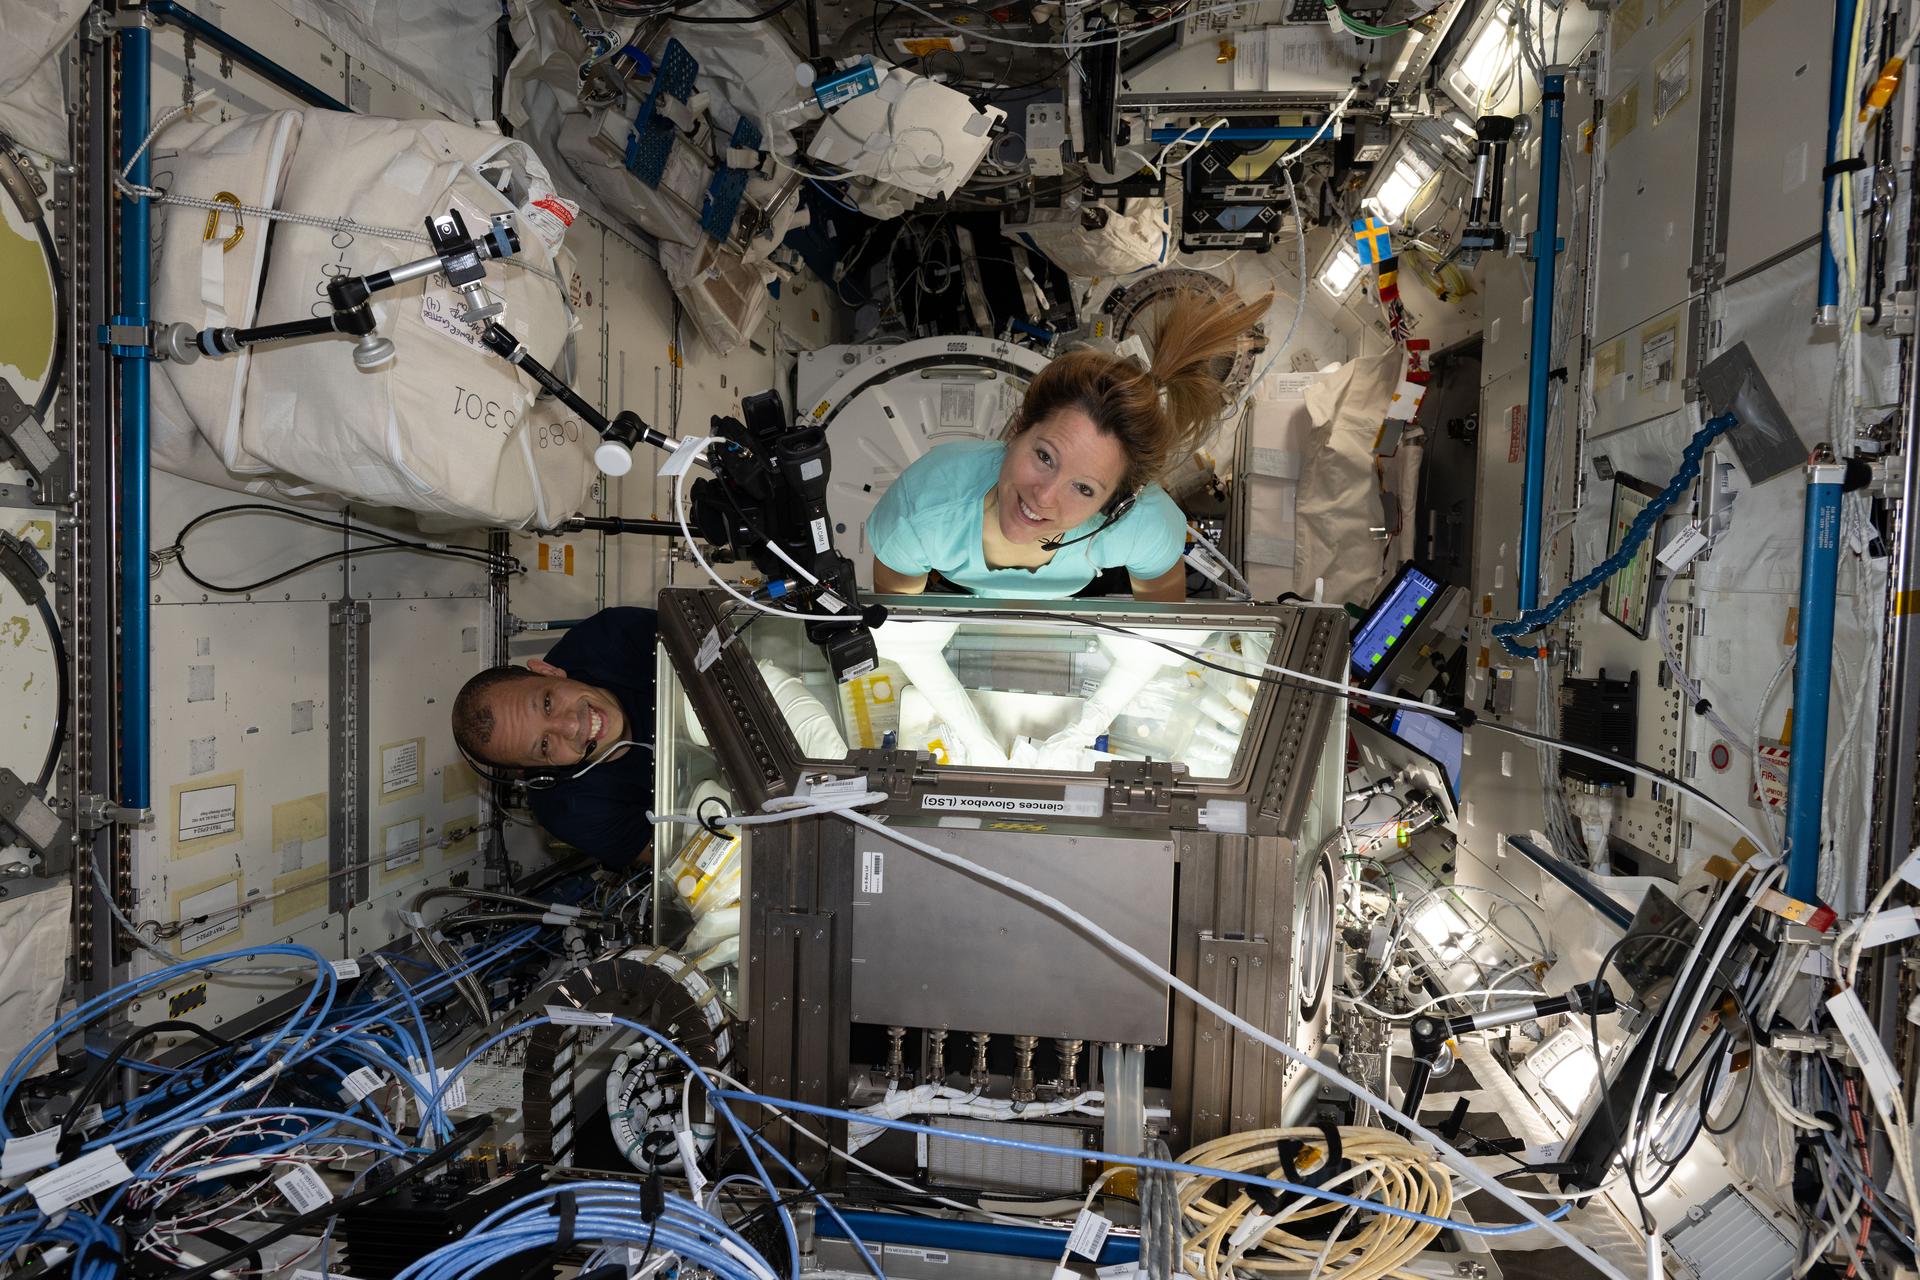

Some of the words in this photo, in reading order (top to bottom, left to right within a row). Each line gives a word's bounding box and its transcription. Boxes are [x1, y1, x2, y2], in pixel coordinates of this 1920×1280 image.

[1761, 770, 1776, 782] FIRE
[923, 797, 957, 807] (LSG)
[960, 799, 1015, 810] Glovebox
[1018, 801, 1071, 813] Sciences
